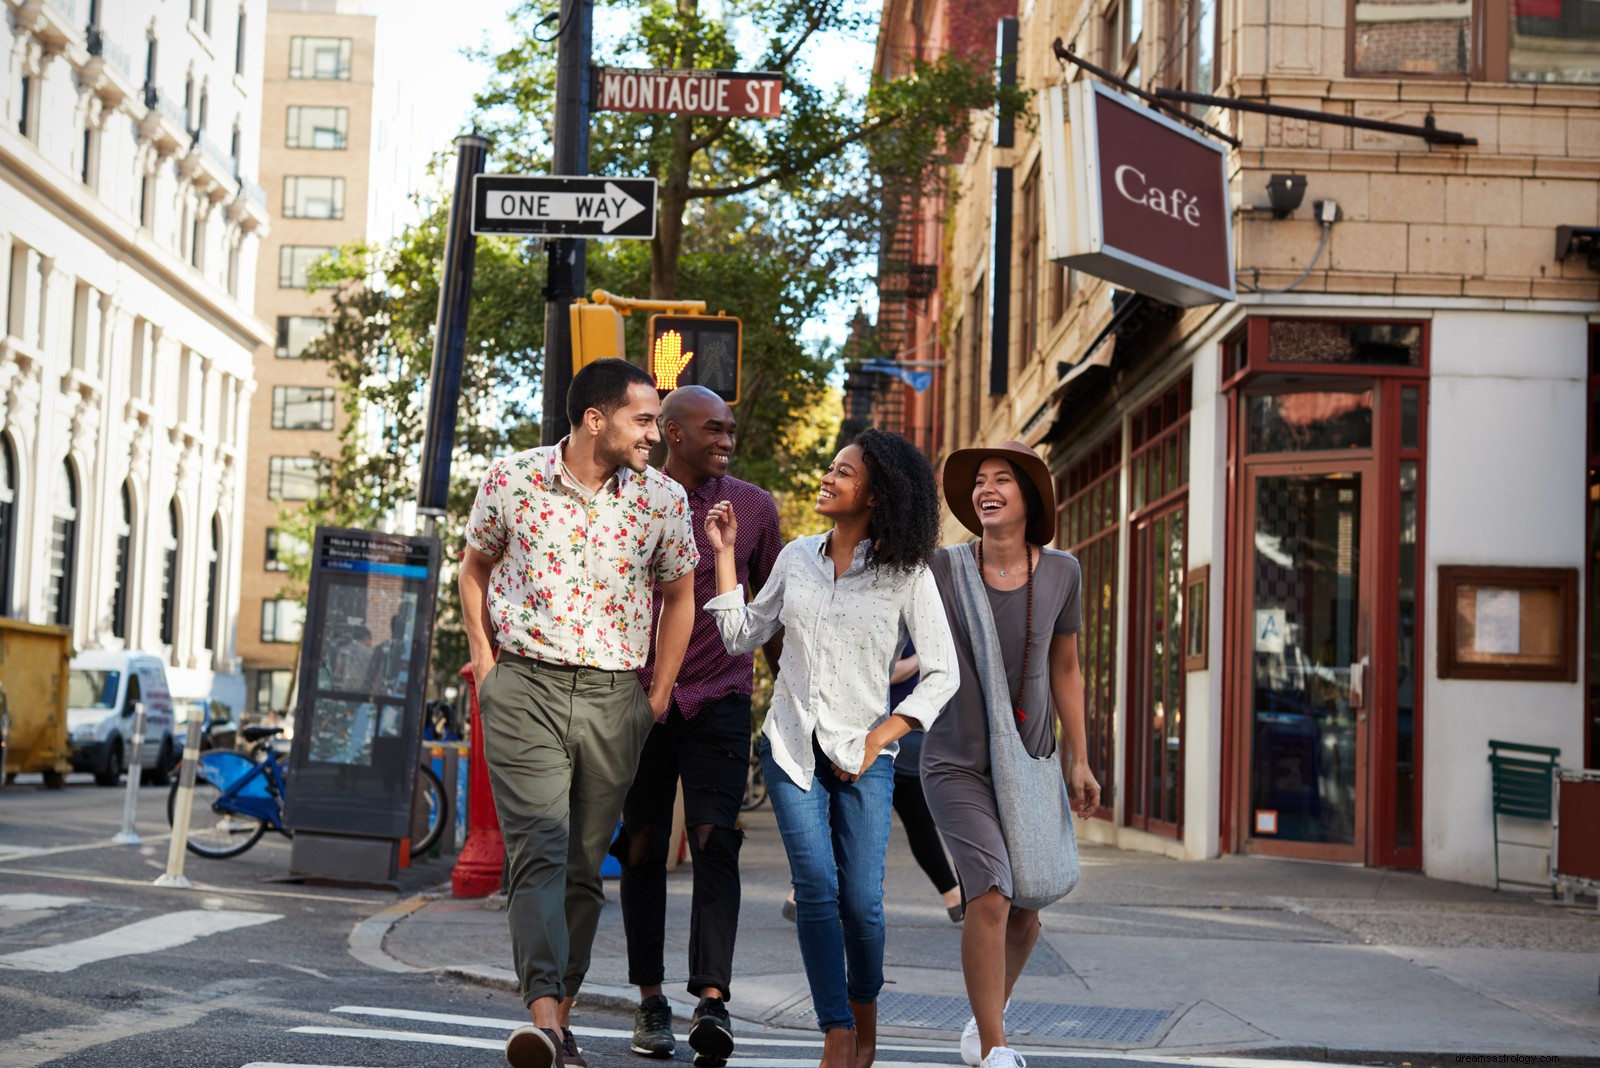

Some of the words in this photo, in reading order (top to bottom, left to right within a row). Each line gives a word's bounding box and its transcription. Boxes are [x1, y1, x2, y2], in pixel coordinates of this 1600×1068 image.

[603, 75, 730, 112] MONTAGUE
[744, 80, 775, 114] ST
[501, 194, 550, 217] ONE
[576, 196, 627, 219] WAY
[1114, 164, 1201, 227] Café
[1261, 615, 1279, 640] A
